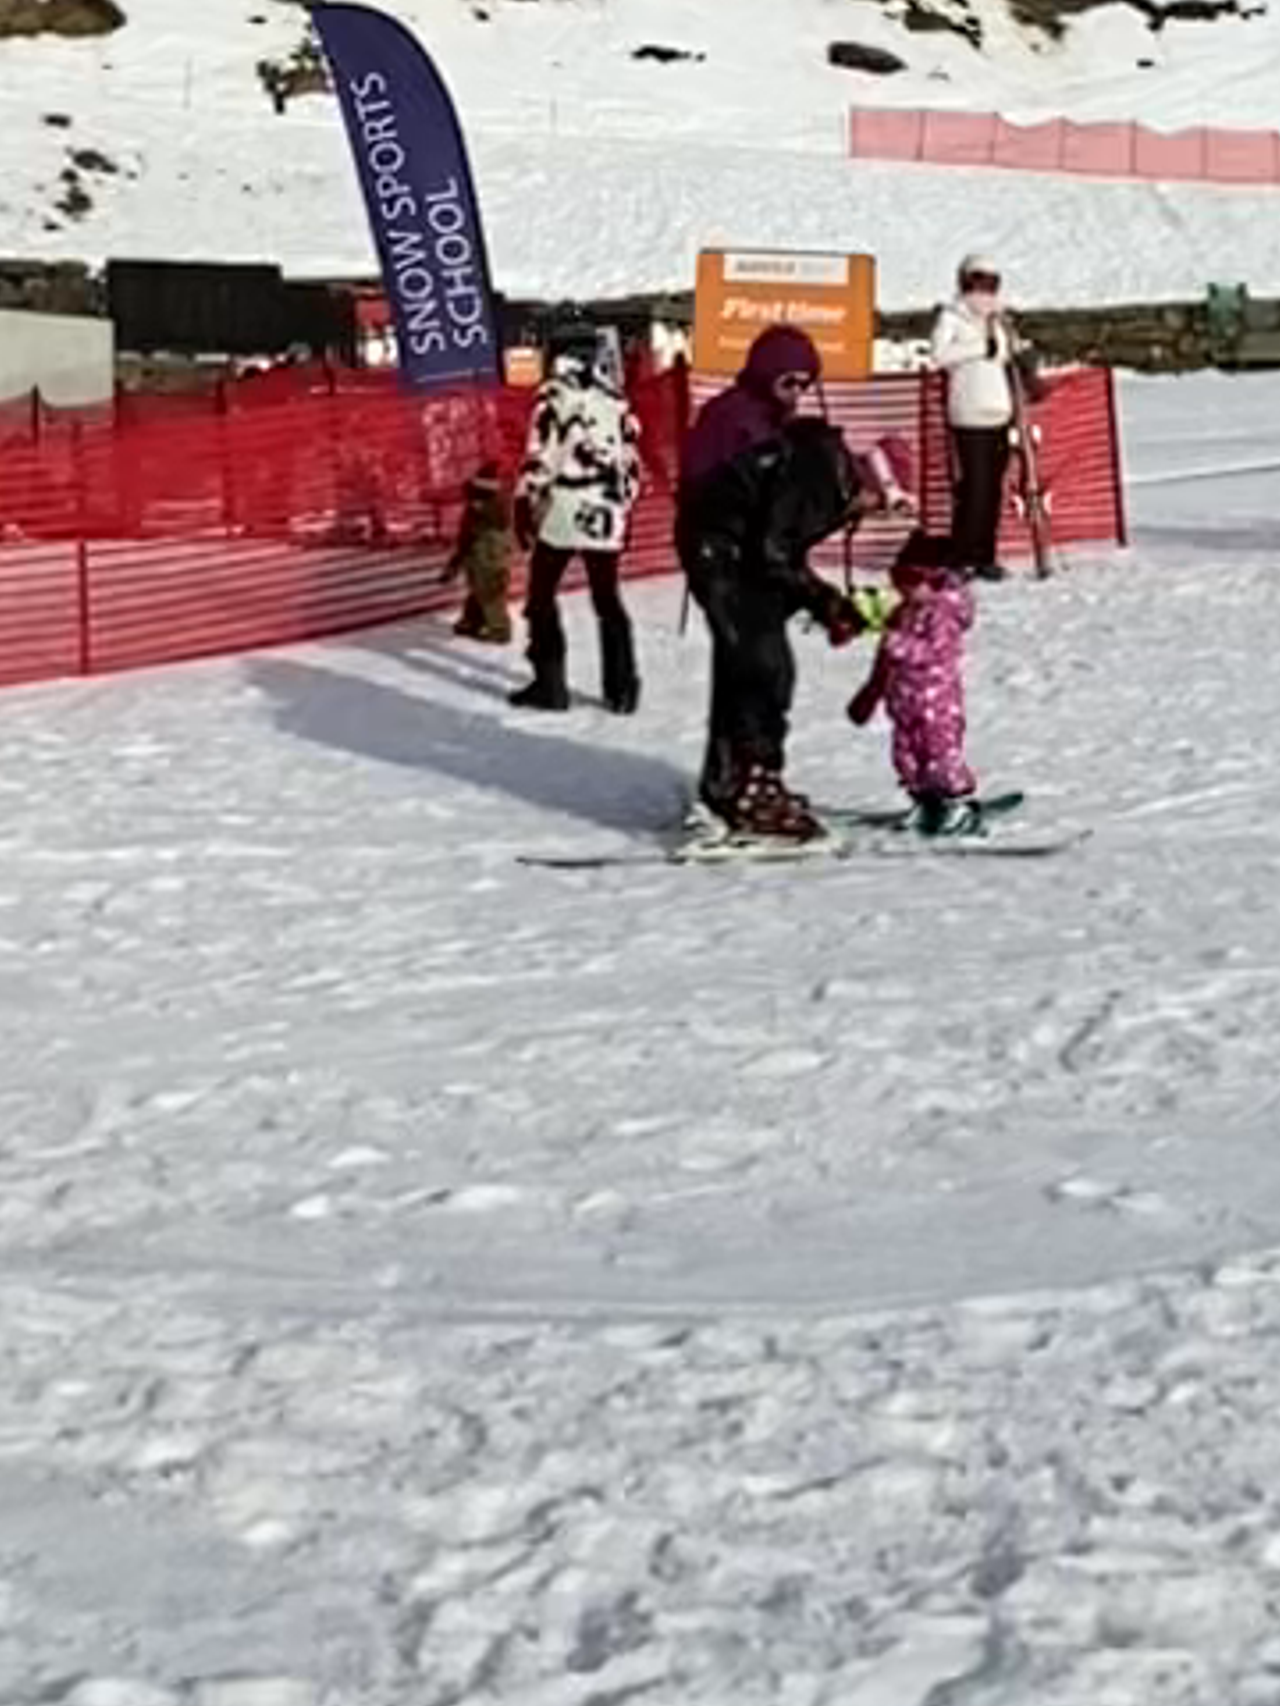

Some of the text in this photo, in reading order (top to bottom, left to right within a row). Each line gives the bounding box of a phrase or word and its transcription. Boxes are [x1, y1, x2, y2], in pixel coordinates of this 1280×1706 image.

[350, 71, 447, 356] SNOW SPORTS
[424, 177, 488, 348] SCHOOL
[721, 297, 783, 323] First
